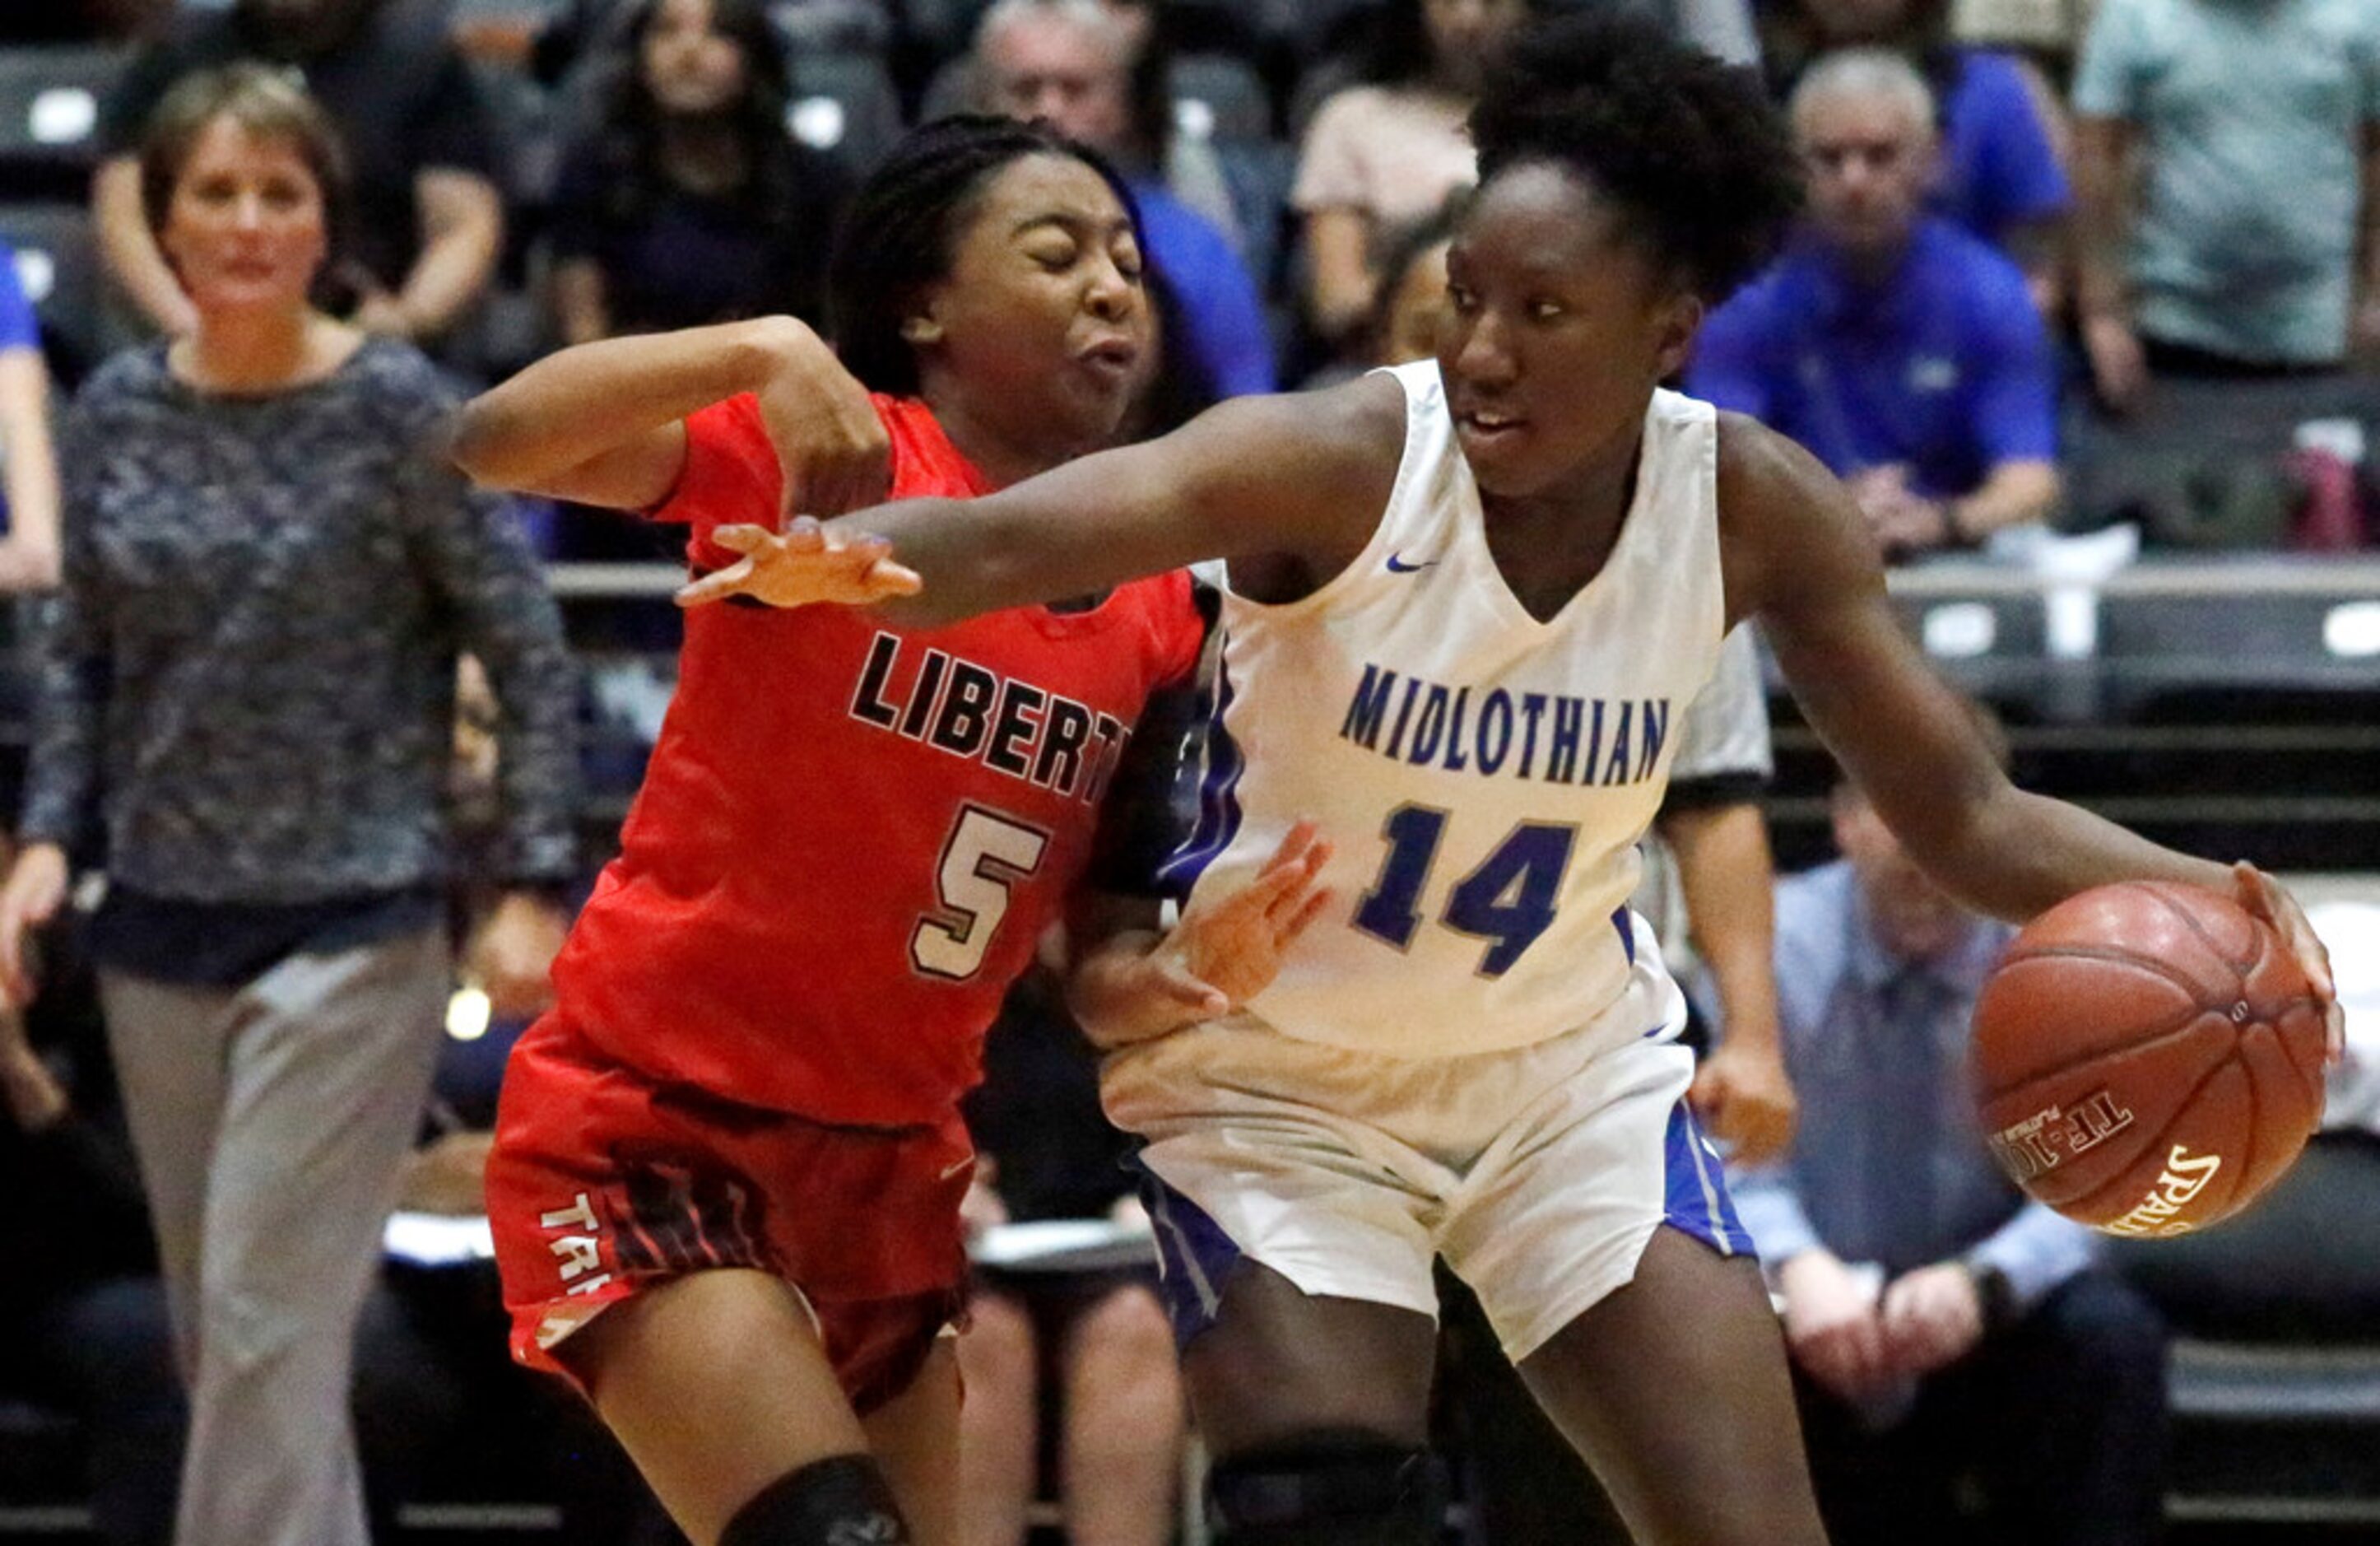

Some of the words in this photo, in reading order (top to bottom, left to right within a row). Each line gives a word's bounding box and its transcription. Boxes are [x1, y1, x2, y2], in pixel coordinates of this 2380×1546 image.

[848, 630, 1133, 806] LIBERT
[1339, 662, 1671, 787] MIDLOTHIAN
[907, 799, 1053, 982] 5
[1349, 800, 1581, 980] 14
[1992, 1091, 2135, 1184] TF-10
[2100, 1144, 2221, 1236] SPALD
